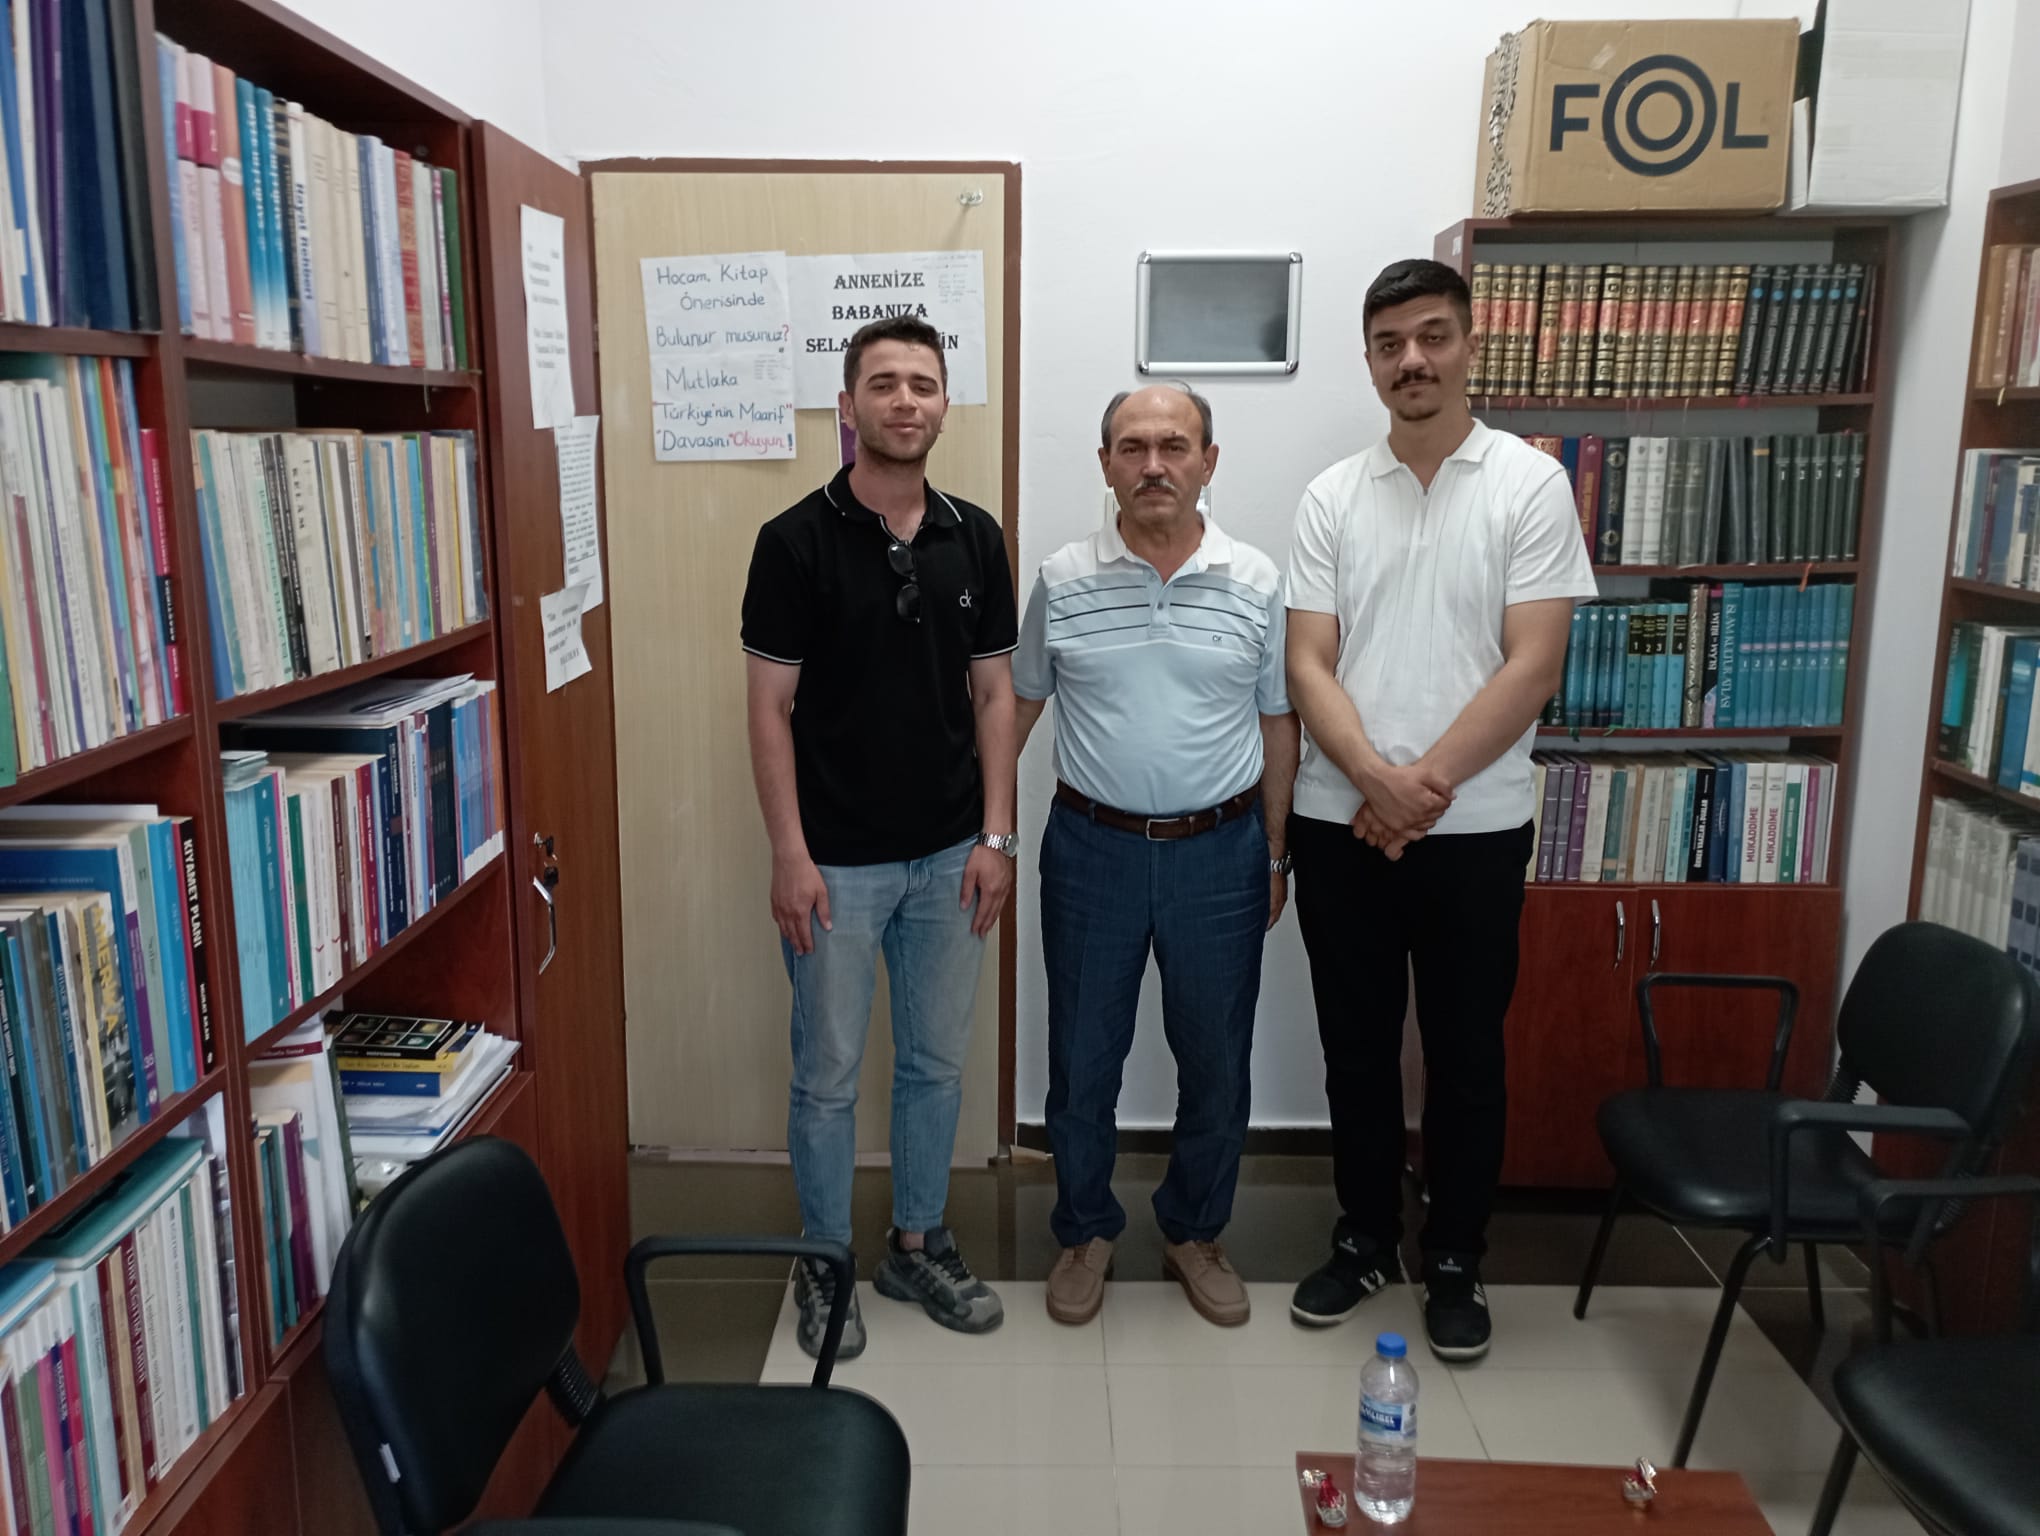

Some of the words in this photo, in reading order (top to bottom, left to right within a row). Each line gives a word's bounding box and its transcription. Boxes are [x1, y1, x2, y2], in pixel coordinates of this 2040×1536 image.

[720, 264, 769, 285] Kitap
[833, 270, 926, 289] ANNENİZE
[680, 292, 766, 310] Önerisinde
[832, 304, 928, 320] BABANIZA
[656, 326, 717, 347] Bulunur
[725, 324, 790, 344] musunuz?
[806, 338, 851, 352] SELA
[666, 366, 739, 392] Mutlaka
[1746, 807, 1758, 863] MUKADDİME
[1766, 808, 1778, 864] MUKADDİME
[184, 838, 199, 903] KIYAMET
[190, 904, 202, 949] PLANI
